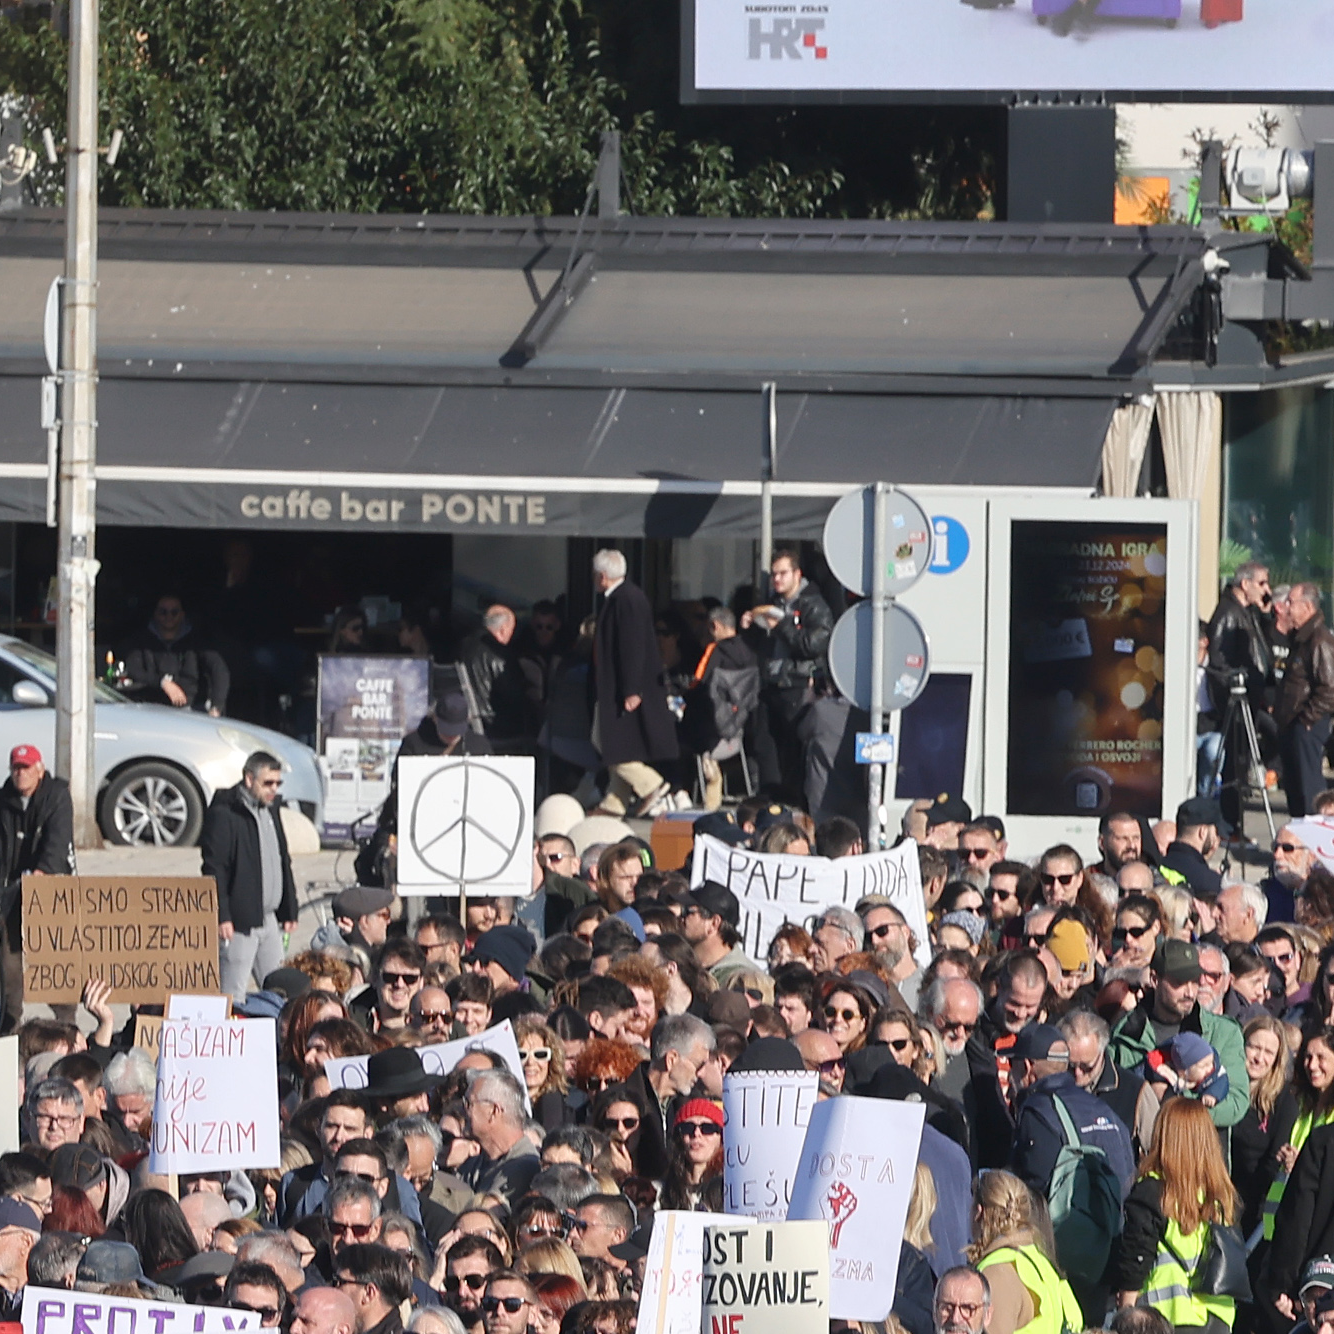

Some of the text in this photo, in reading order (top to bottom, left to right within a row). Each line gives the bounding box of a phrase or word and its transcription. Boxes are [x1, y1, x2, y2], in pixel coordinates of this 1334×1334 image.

[748, 18, 827, 59] HRT
[240, 489, 547, 525] caffe bar PONTE
[355, 678, 394, 693] CAFFE
[361, 692, 387, 706] BAR
[351, 705, 393, 720] PONTE
[726, 850, 820, 904] PAPE
[28, 887, 214, 916] A MI SMO STRANCI
[27, 925, 42, 954] U
[47, 923, 142, 953] VLASTITOJ
[28, 963, 77, 991] ZBOG
[163, 1023, 246, 1059] AŠIZAM
[156, 1070, 207, 1123] nije
[152, 1120, 257, 1155] UNIZAM
[726, 1144, 751, 1168] CU
[809, 1152, 896, 1185] DOSTA
[765, 1230, 774, 1262] I
[832, 1257, 875, 1282] ZMA
[702, 1270, 824, 1308] ZOVANJE,
